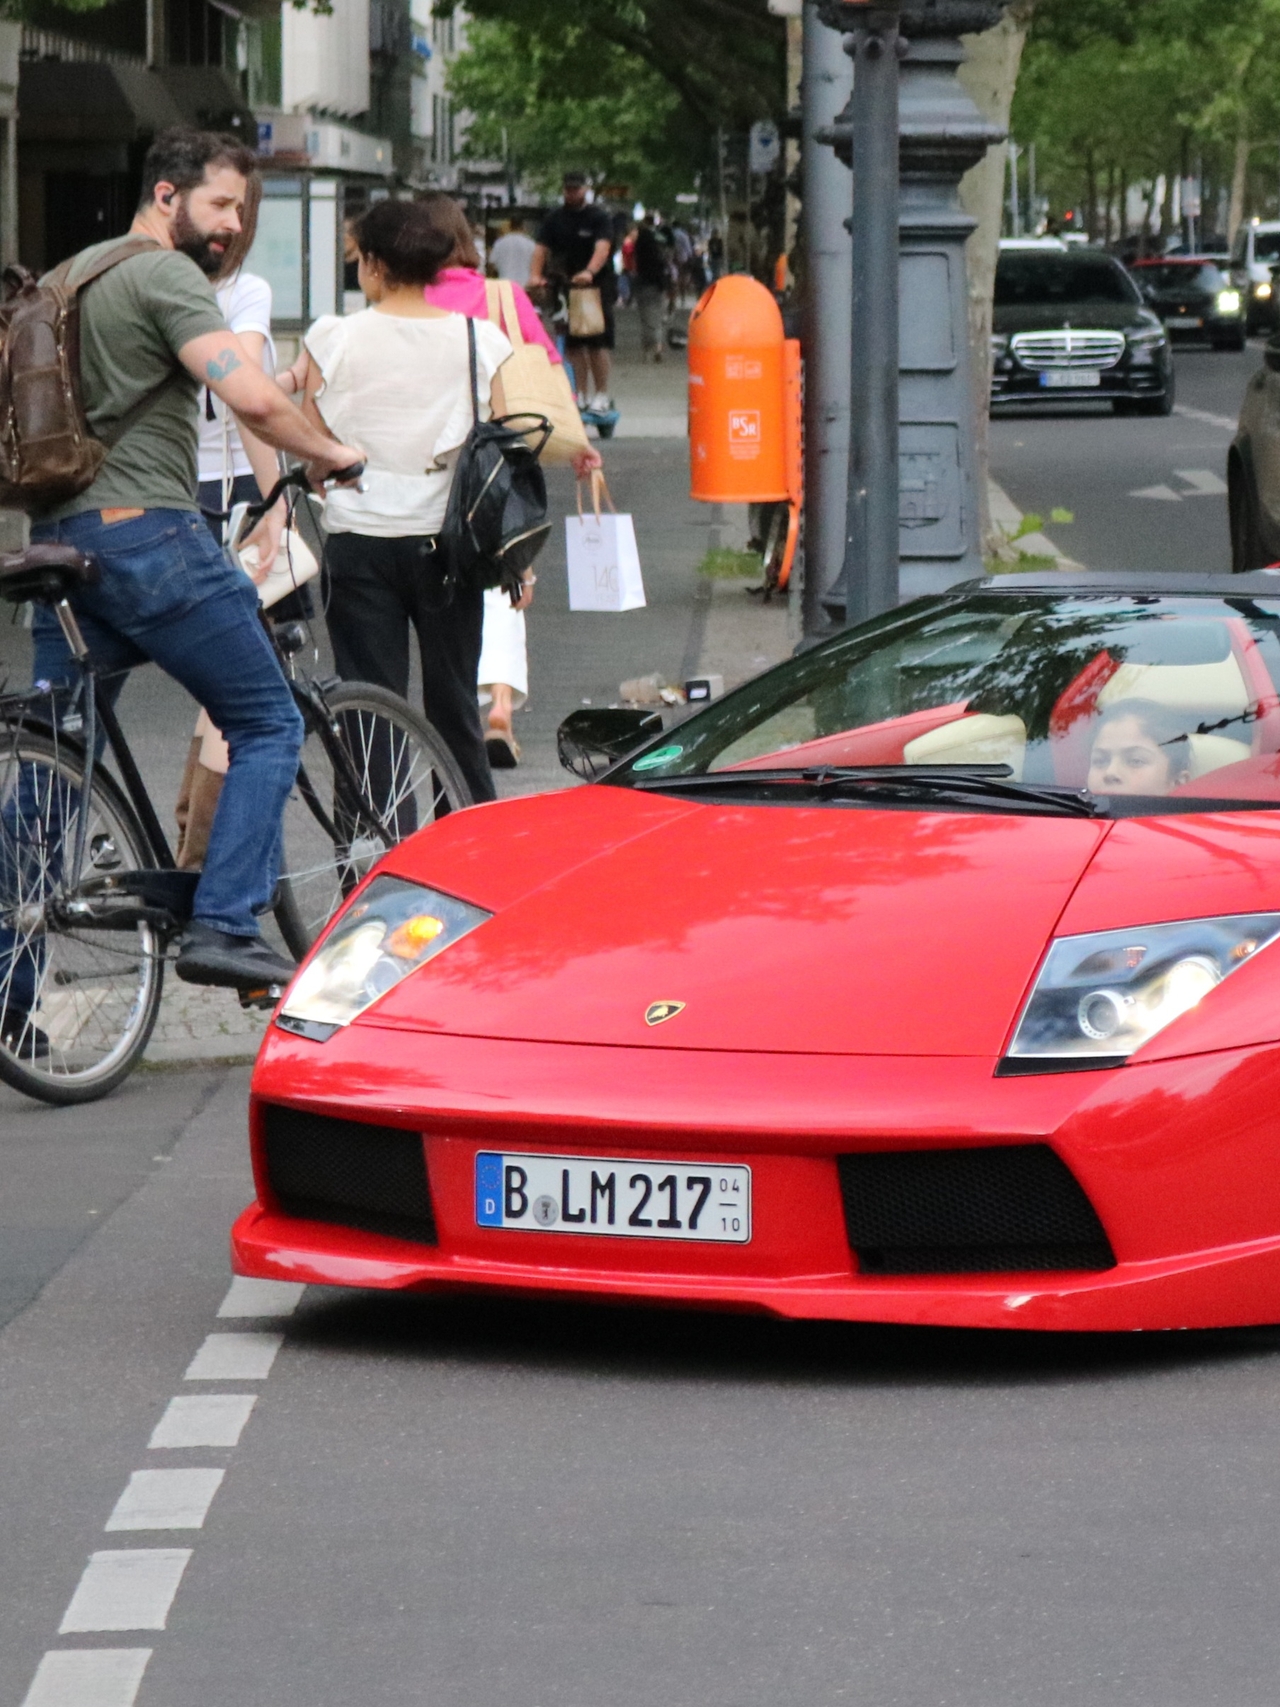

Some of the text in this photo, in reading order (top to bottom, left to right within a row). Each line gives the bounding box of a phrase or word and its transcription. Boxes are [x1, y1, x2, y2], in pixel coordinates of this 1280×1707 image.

[732, 416, 757, 436] BSR
[719, 1178, 740, 1193] 04
[504, 1165, 712, 1230] B LM 217
[485, 1198, 496, 1215] D
[721, 1217, 741, 1232] 10
